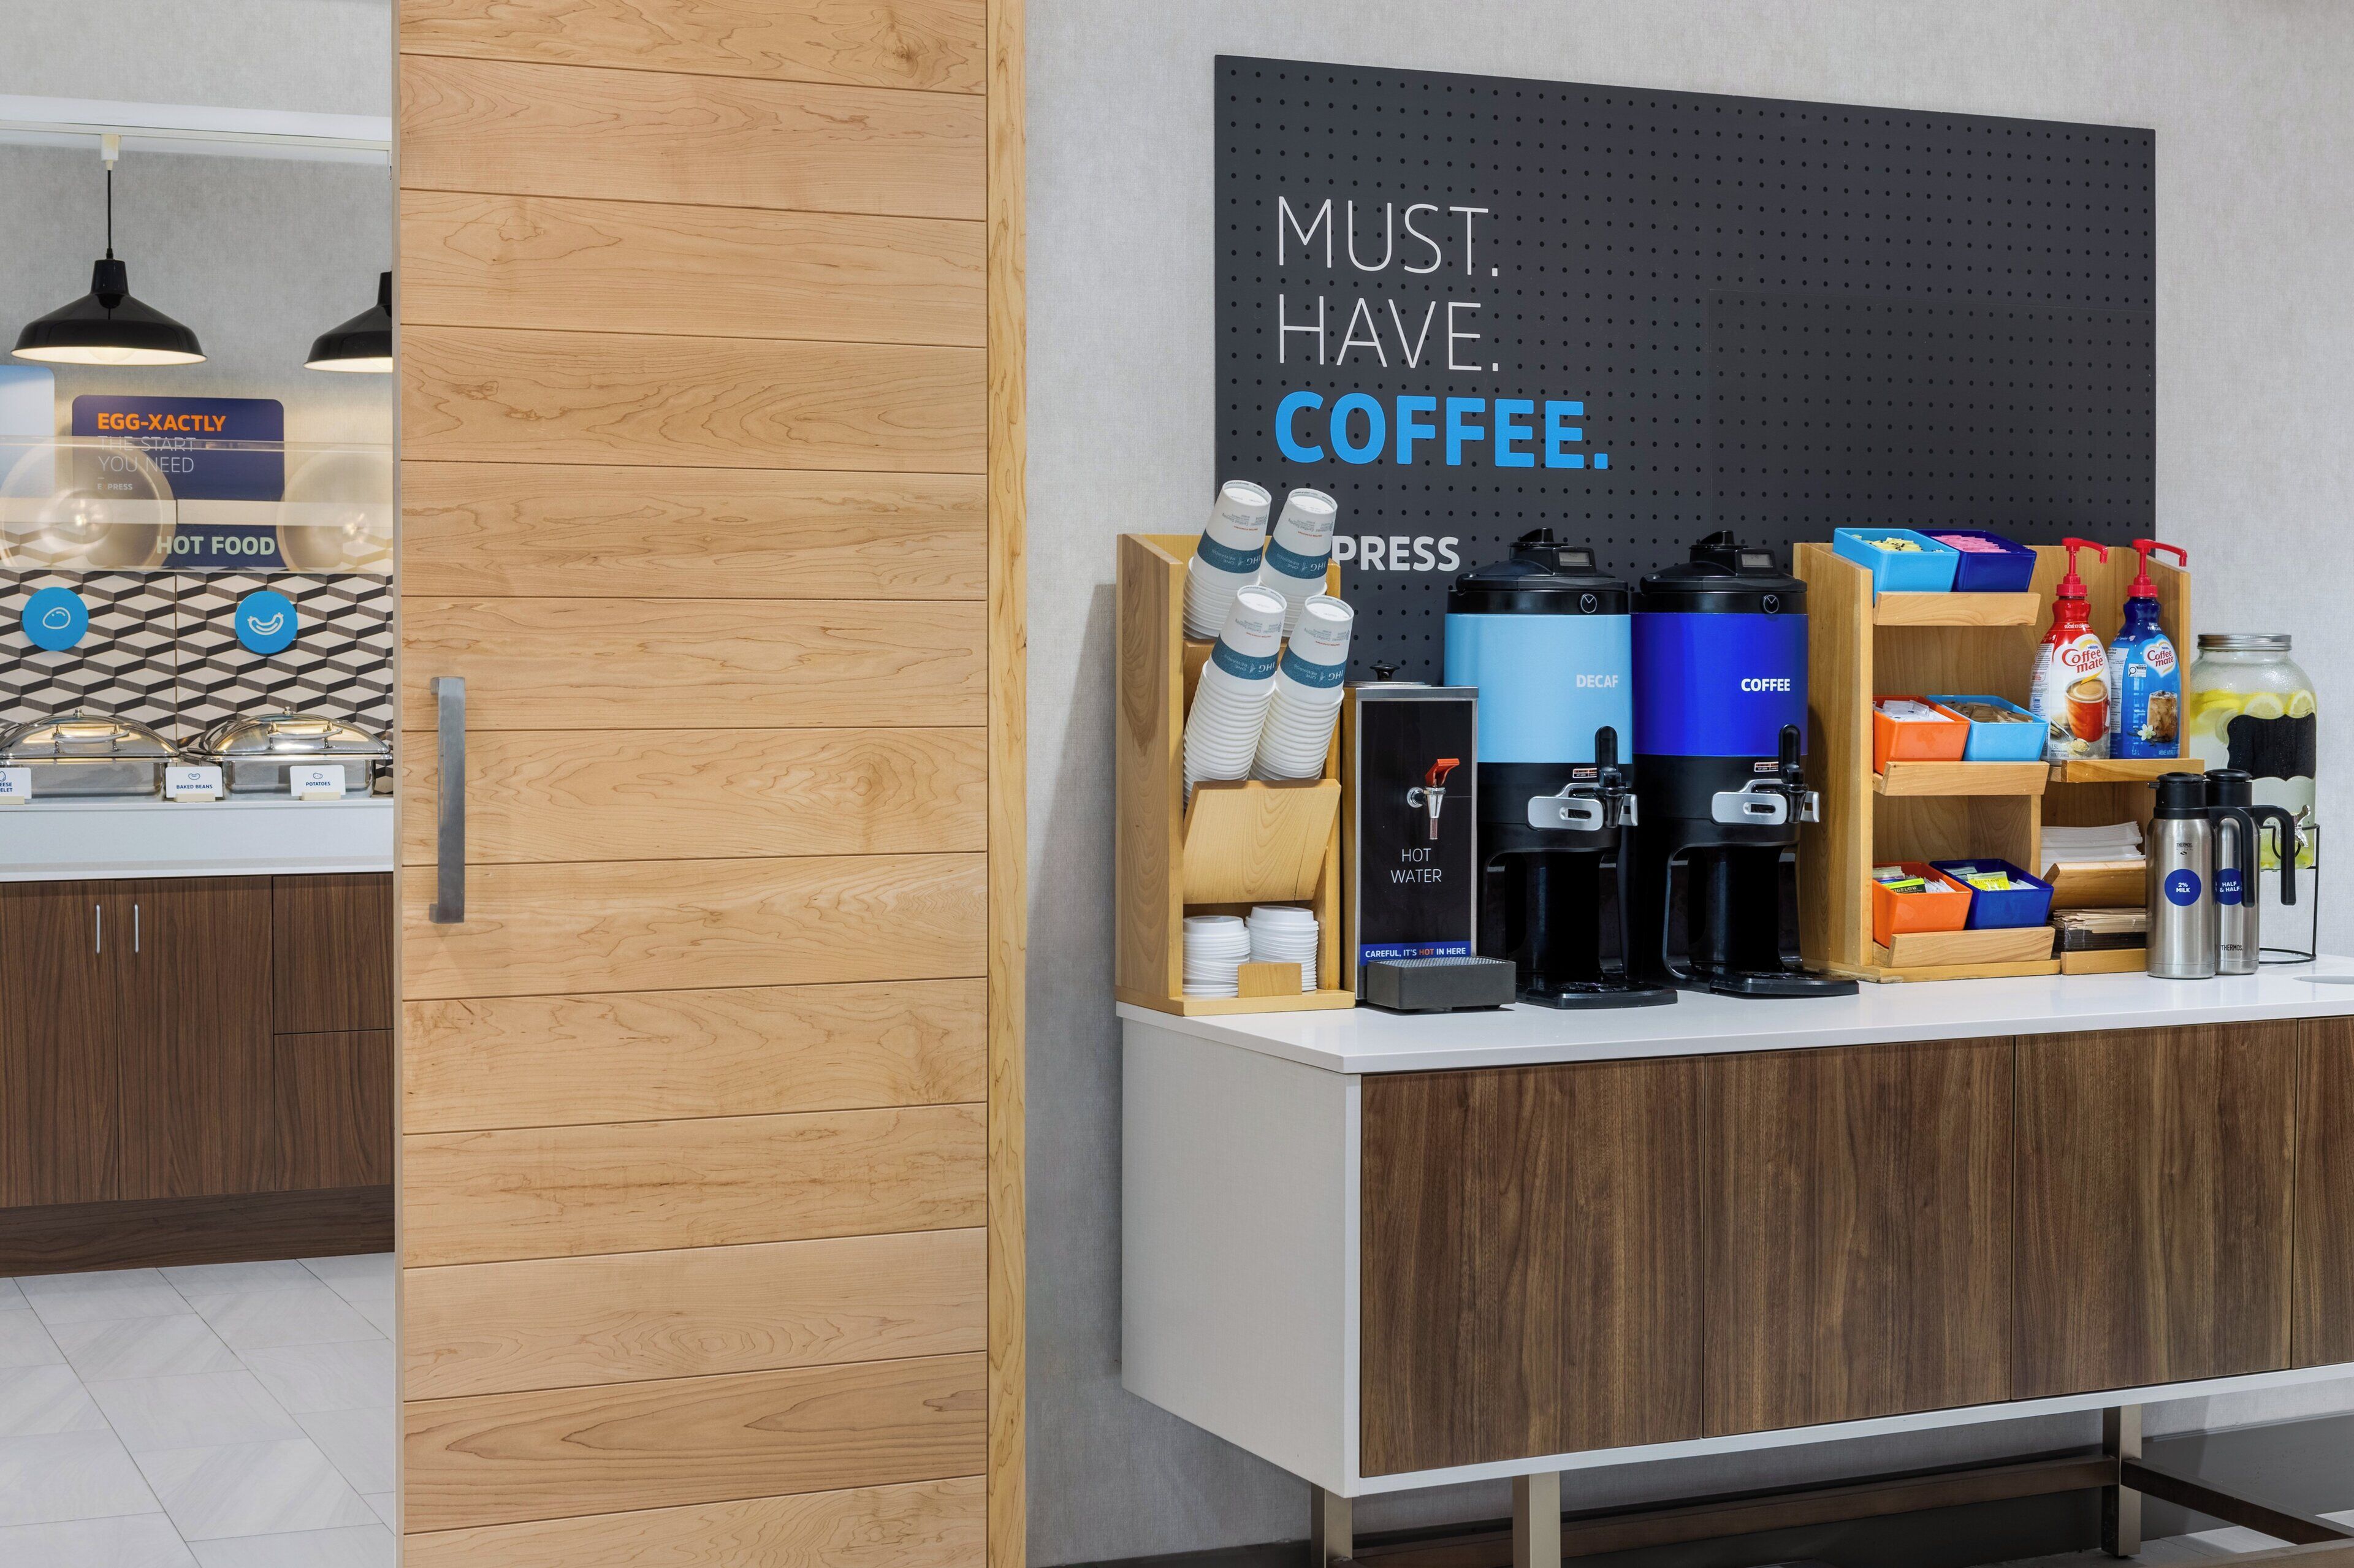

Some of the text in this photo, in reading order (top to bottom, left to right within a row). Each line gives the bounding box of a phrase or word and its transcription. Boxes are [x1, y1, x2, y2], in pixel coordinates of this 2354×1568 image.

[1279, 196, 1498, 276] MUST.
[1279, 294, 1499, 371] HAVE.
[97, 413, 226, 432] EGG-XACTLY
[1275, 390, 1609, 470] COFFEE.
[97, 435, 196, 452] THE START
[97, 455, 194, 473] YOU NEED
[156, 536, 275, 555] HOT FOOD
[1246, 554, 1260, 566] IHG
[1310, 560, 1326, 571] IHG
[2062, 648, 2101, 667] Coffee
[2147, 650, 2172, 661] Coffee
[2155, 656, 2174, 667] mate
[1259, 661, 1275, 672] IHG
[2076, 656, 2103, 673] mate
[1328, 669, 1344, 681] IHG
[1576, 674, 1618, 688] DECAF
[1741, 678, 1791, 692] COFFEE
[1401, 848, 1432, 862] HOT
[1390, 869, 1442, 883] WATER
